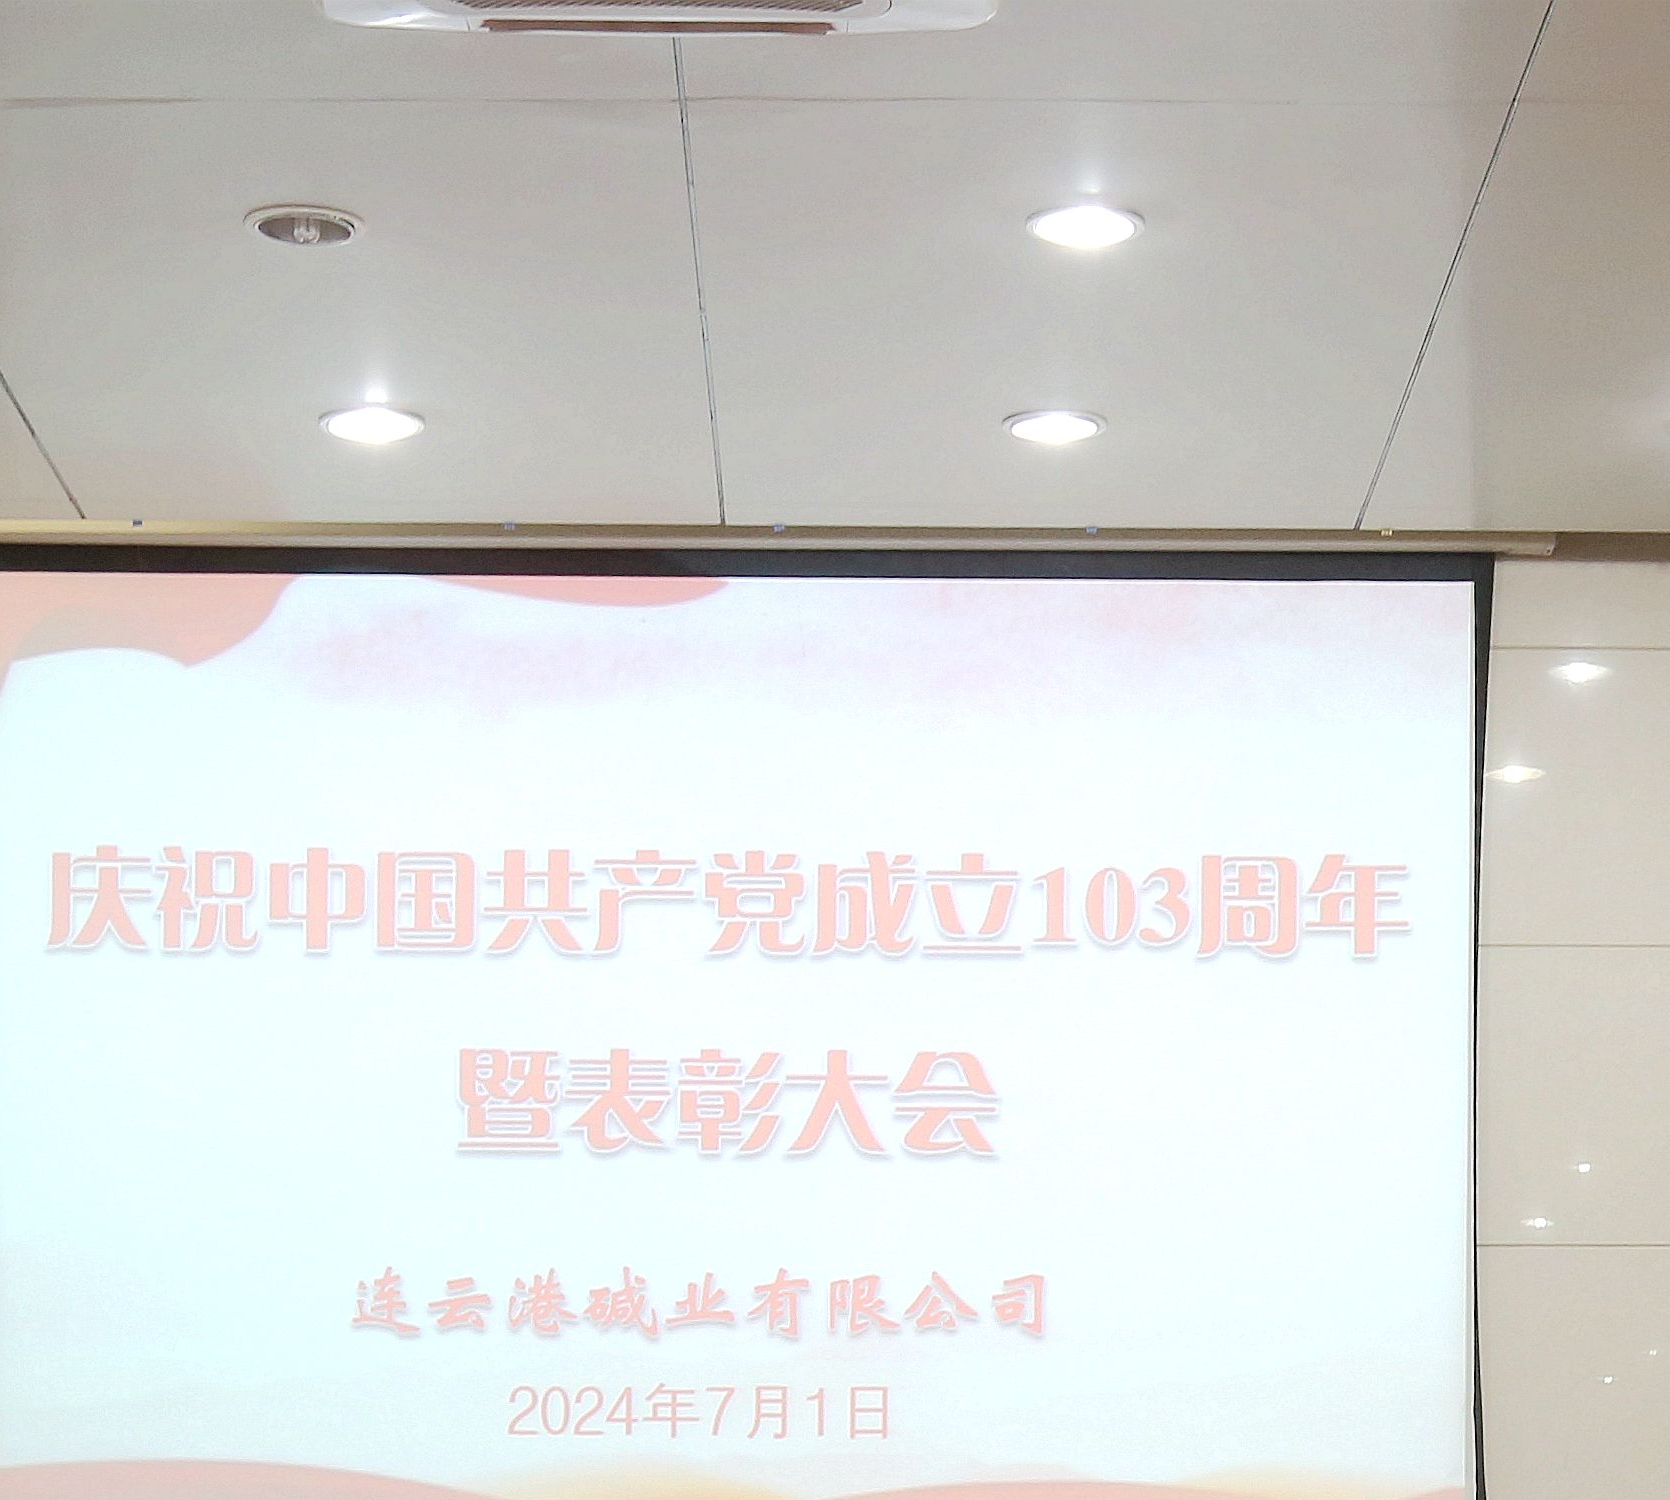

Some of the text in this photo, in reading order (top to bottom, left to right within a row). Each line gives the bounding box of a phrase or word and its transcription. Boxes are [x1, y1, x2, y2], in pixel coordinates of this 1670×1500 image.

[43, 844, 1413, 960] 庆祝中国共产党成立103周年
[454, 1046, 1001, 1156] 暨表彰大会
[350, 1265, 1049, 1338] 连云港碱业有限公司
[506, 1381, 892, 1440] 2024年7月1日
